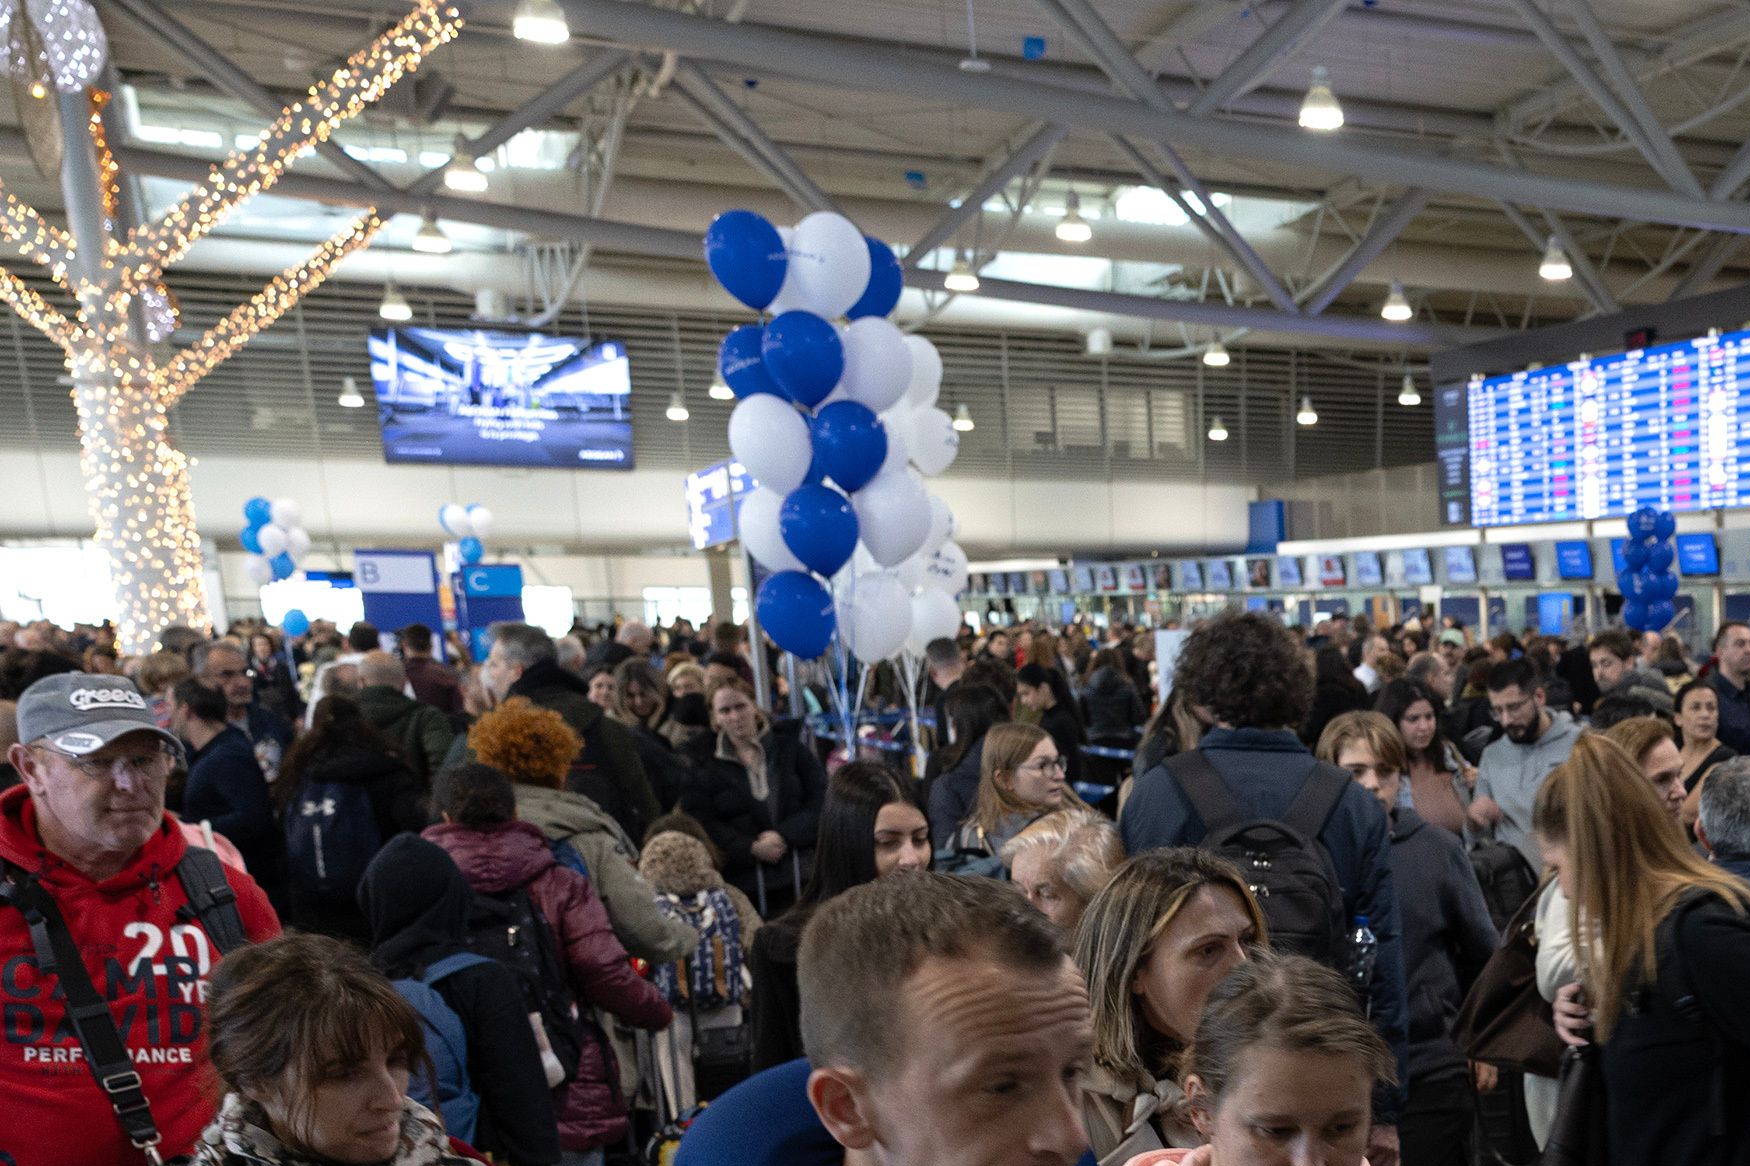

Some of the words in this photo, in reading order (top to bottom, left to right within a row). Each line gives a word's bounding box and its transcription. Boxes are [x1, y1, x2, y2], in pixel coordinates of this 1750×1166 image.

[360, 561, 381, 584] B
[469, 571, 490, 592] C
[124, 922, 211, 977] 20
[2, 954, 200, 1001] CMP
[23, 1046, 193, 1064] PERFANCE
